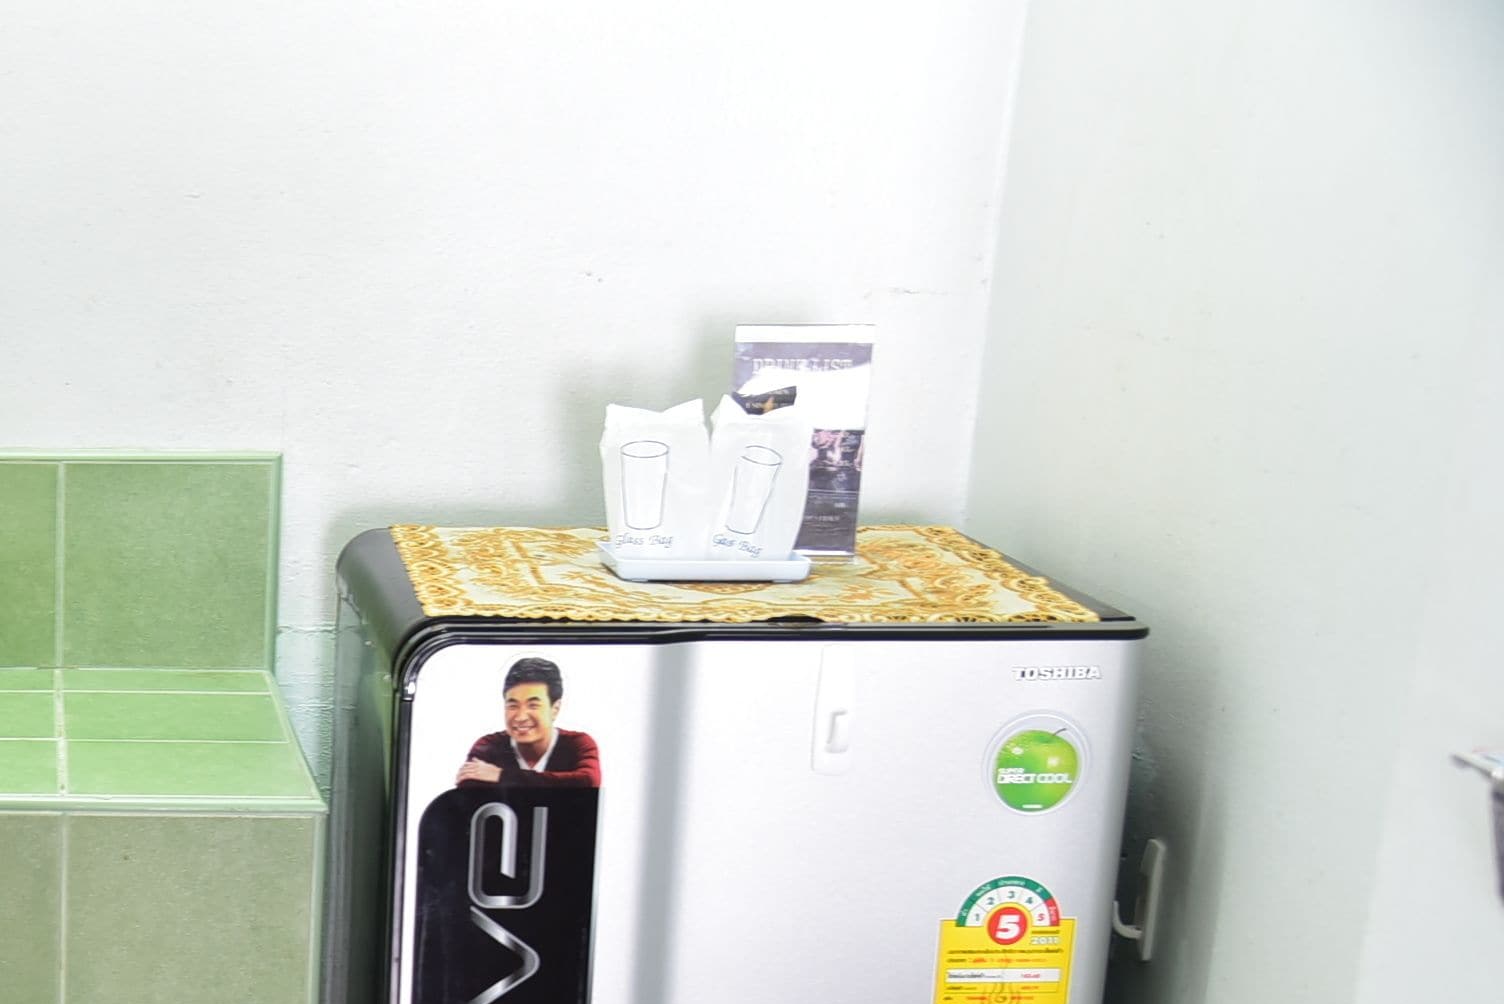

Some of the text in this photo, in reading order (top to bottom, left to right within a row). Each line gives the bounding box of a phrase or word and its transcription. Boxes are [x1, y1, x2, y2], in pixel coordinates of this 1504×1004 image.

[1011, 664, 1102, 681] TOSHIBA
[1036, 773, 1073, 784] COOL
[987, 896, 995, 906] 2
[1007, 890, 1016, 899] 3
[1024, 896, 1034, 905] 4
[1037, 913, 1046, 922] 5
[995, 913, 1021, 940] 5
